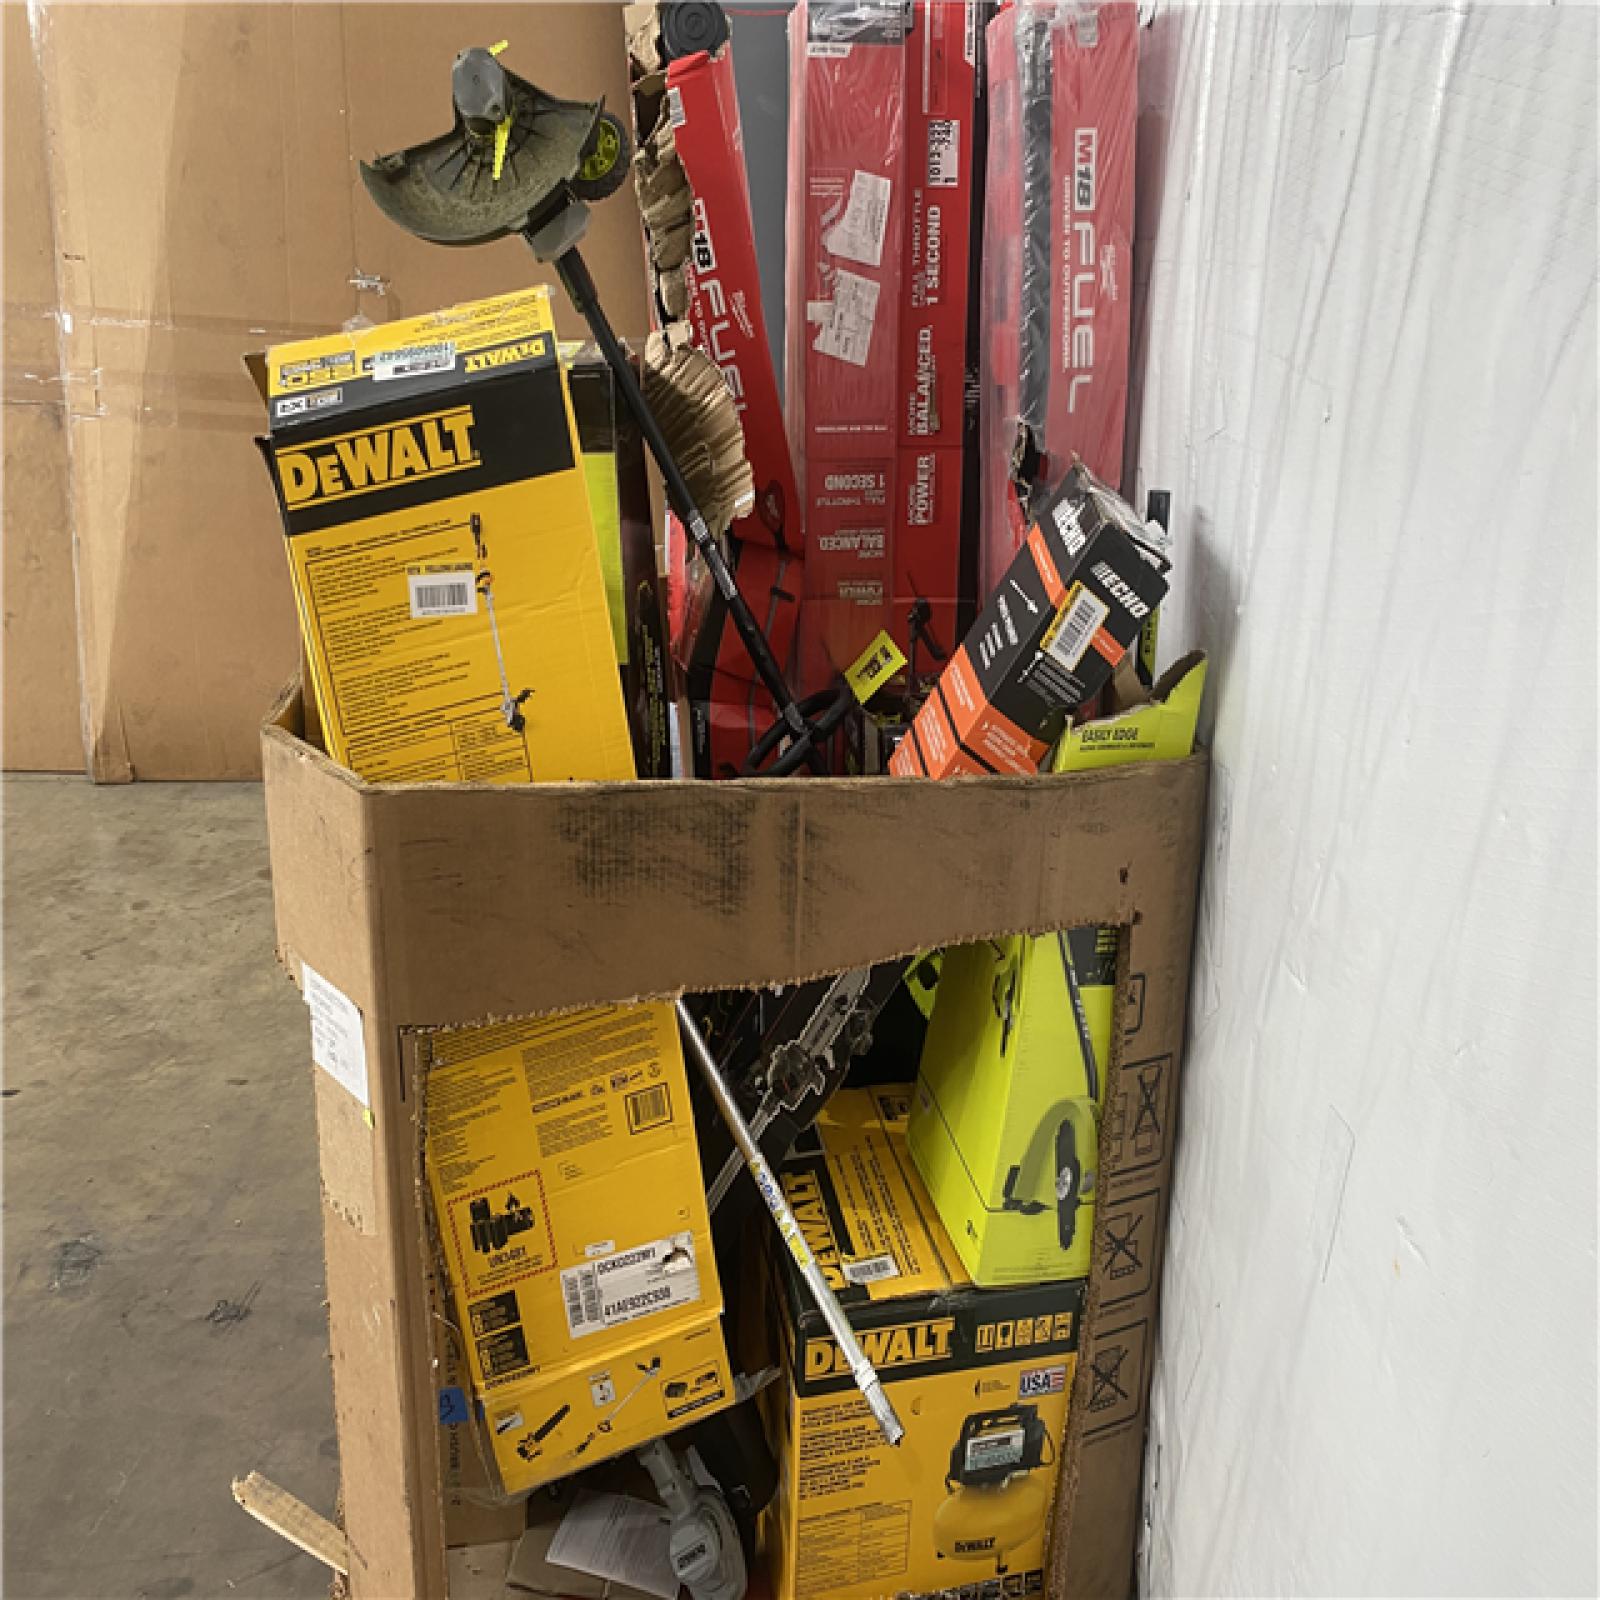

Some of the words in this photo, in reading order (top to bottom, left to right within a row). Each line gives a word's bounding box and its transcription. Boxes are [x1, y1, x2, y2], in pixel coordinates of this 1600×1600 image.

[1075, 134, 1093, 207] M18
[926, 206, 941, 289] SECOND
[700, 279, 748, 411] FUE
[1066, 220, 1096, 414] FUEL
[916, 456, 930, 525] POWER
[1101, 573, 1151, 619] ECHO
[1020, 1370, 1052, 1394] USA
